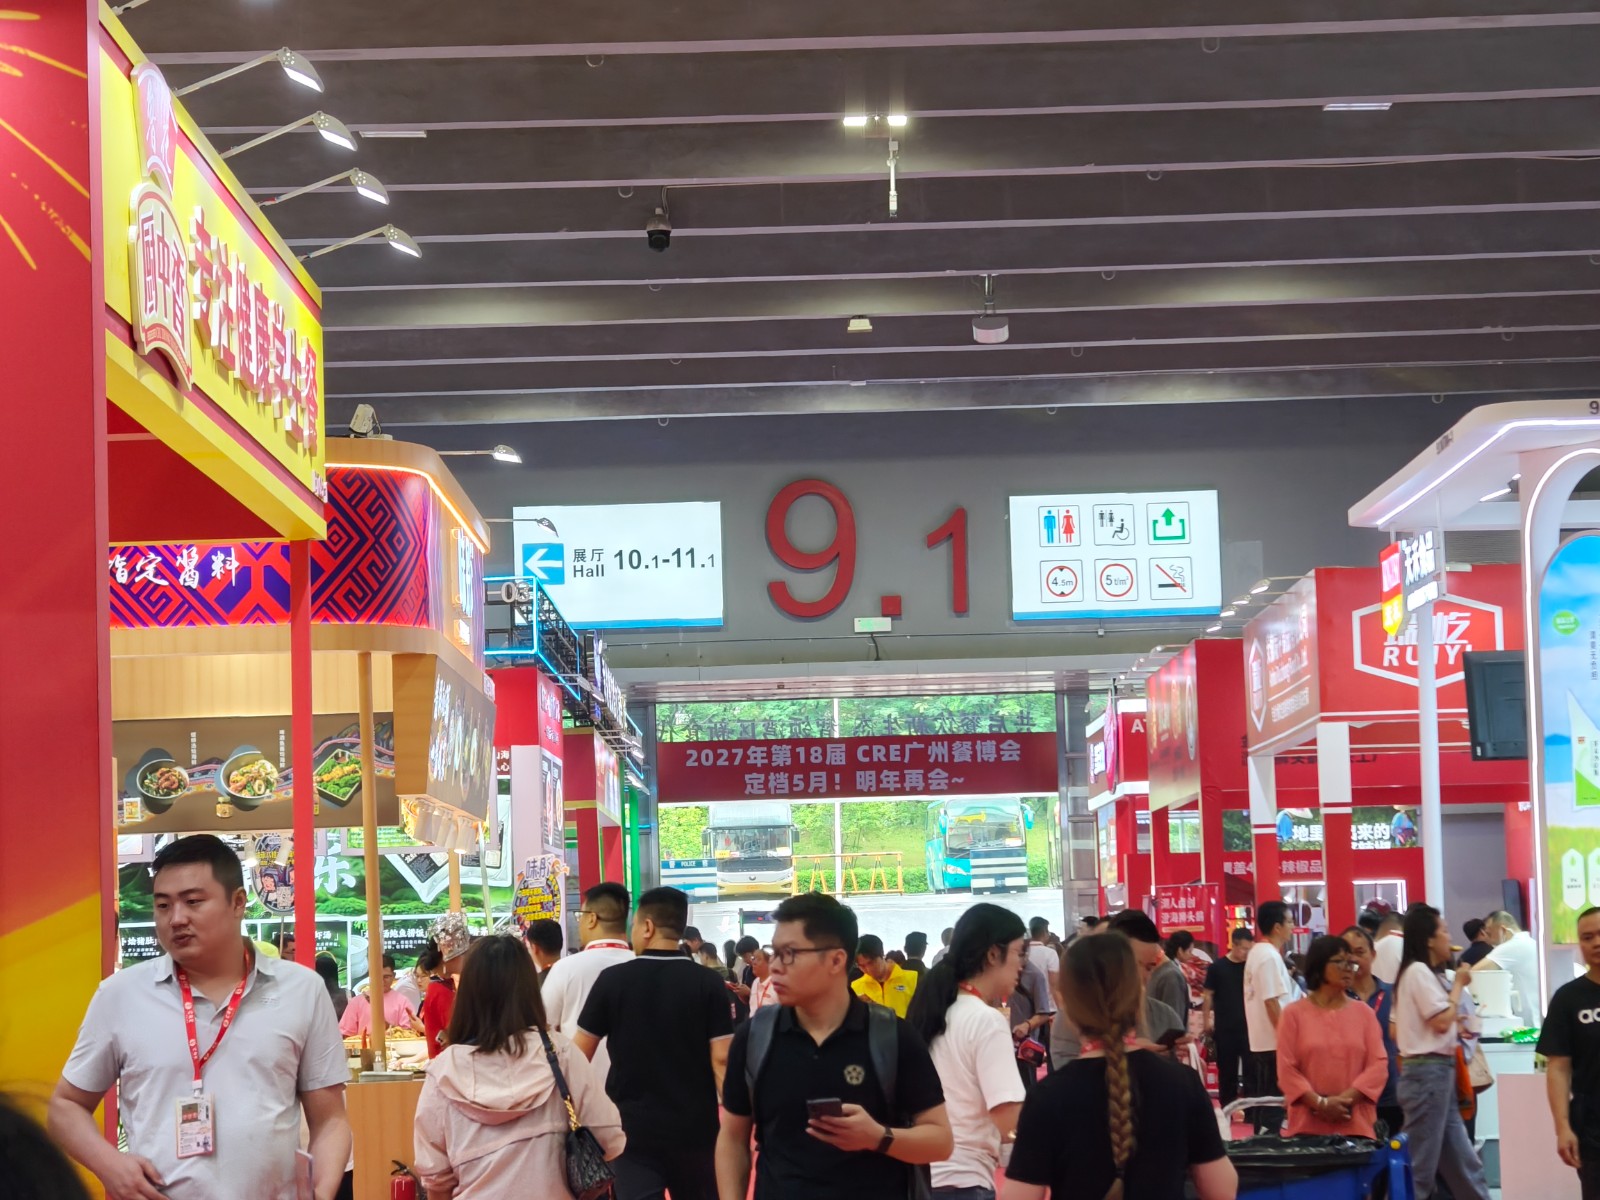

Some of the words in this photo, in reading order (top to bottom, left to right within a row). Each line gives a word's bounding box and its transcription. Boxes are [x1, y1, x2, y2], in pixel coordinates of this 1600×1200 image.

[573, 548, 604, 563] 展厅
[766, 479, 968, 617] 9.1
[614, 547, 715, 571] 10.1-11.1
[573, 565, 605, 578] Hall
[1051, 576, 1074, 587] 4.5m
[686, 744, 847, 768] 2027年第18届
[857, 740, 1021, 764] CRE广州餐博会
